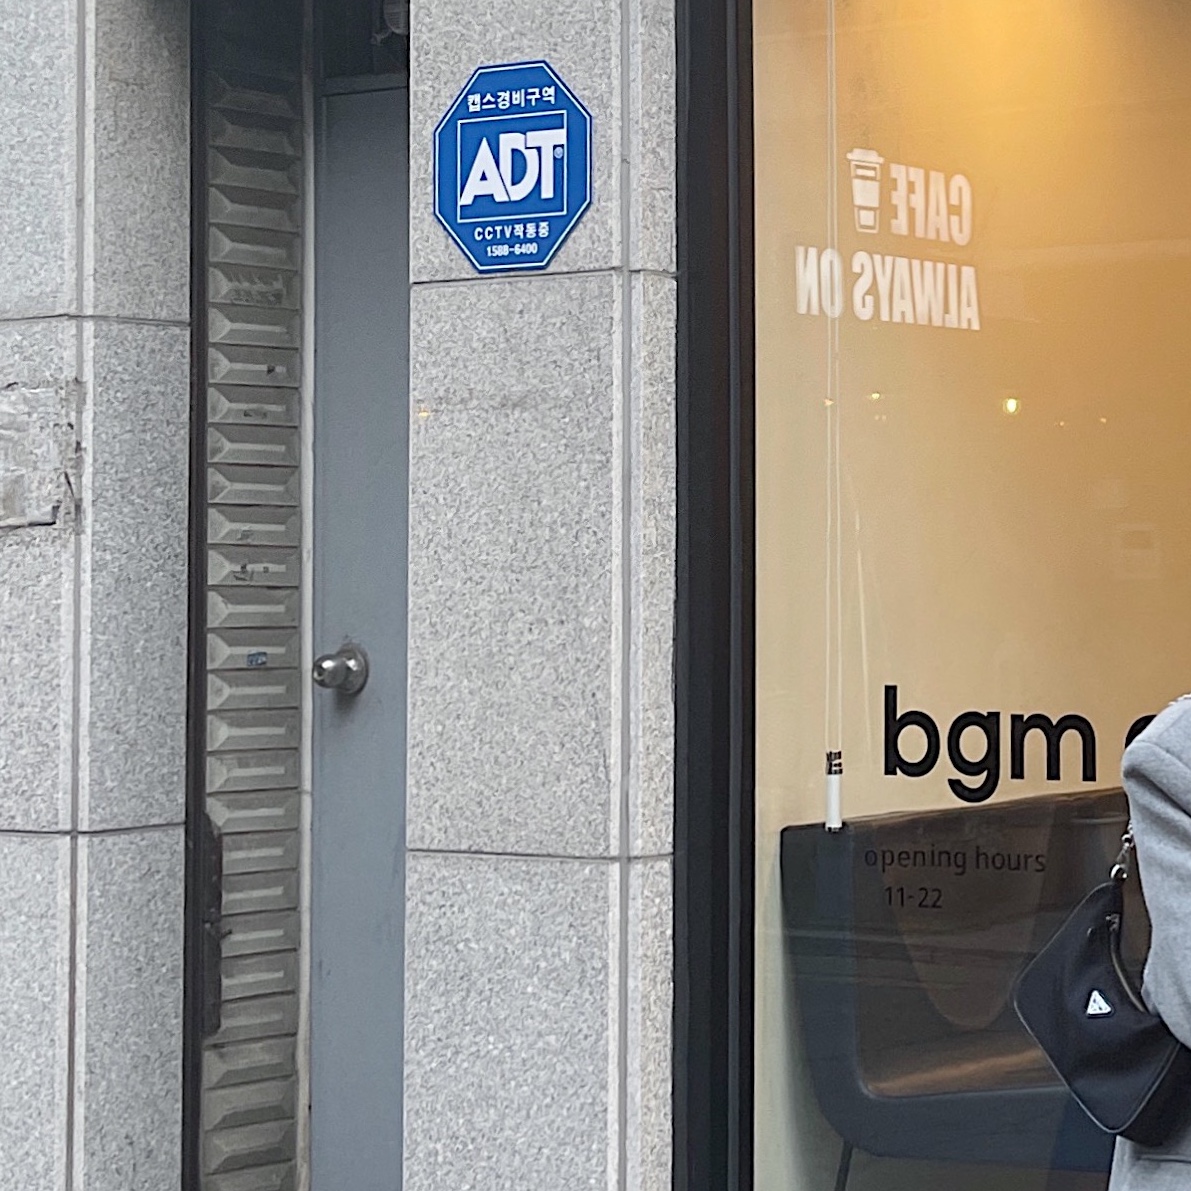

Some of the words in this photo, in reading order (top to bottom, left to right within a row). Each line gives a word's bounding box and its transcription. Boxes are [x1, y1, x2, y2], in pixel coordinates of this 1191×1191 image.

[460, 128, 566, 206] ADT
[486, 242, 538, 257] 1588-6400
[883, 684, 1097, 803] bgm
[864, 844, 967, 877] opening
[975, 845, 1047, 873] hours
[884, 886, 943, 909] 11-22
